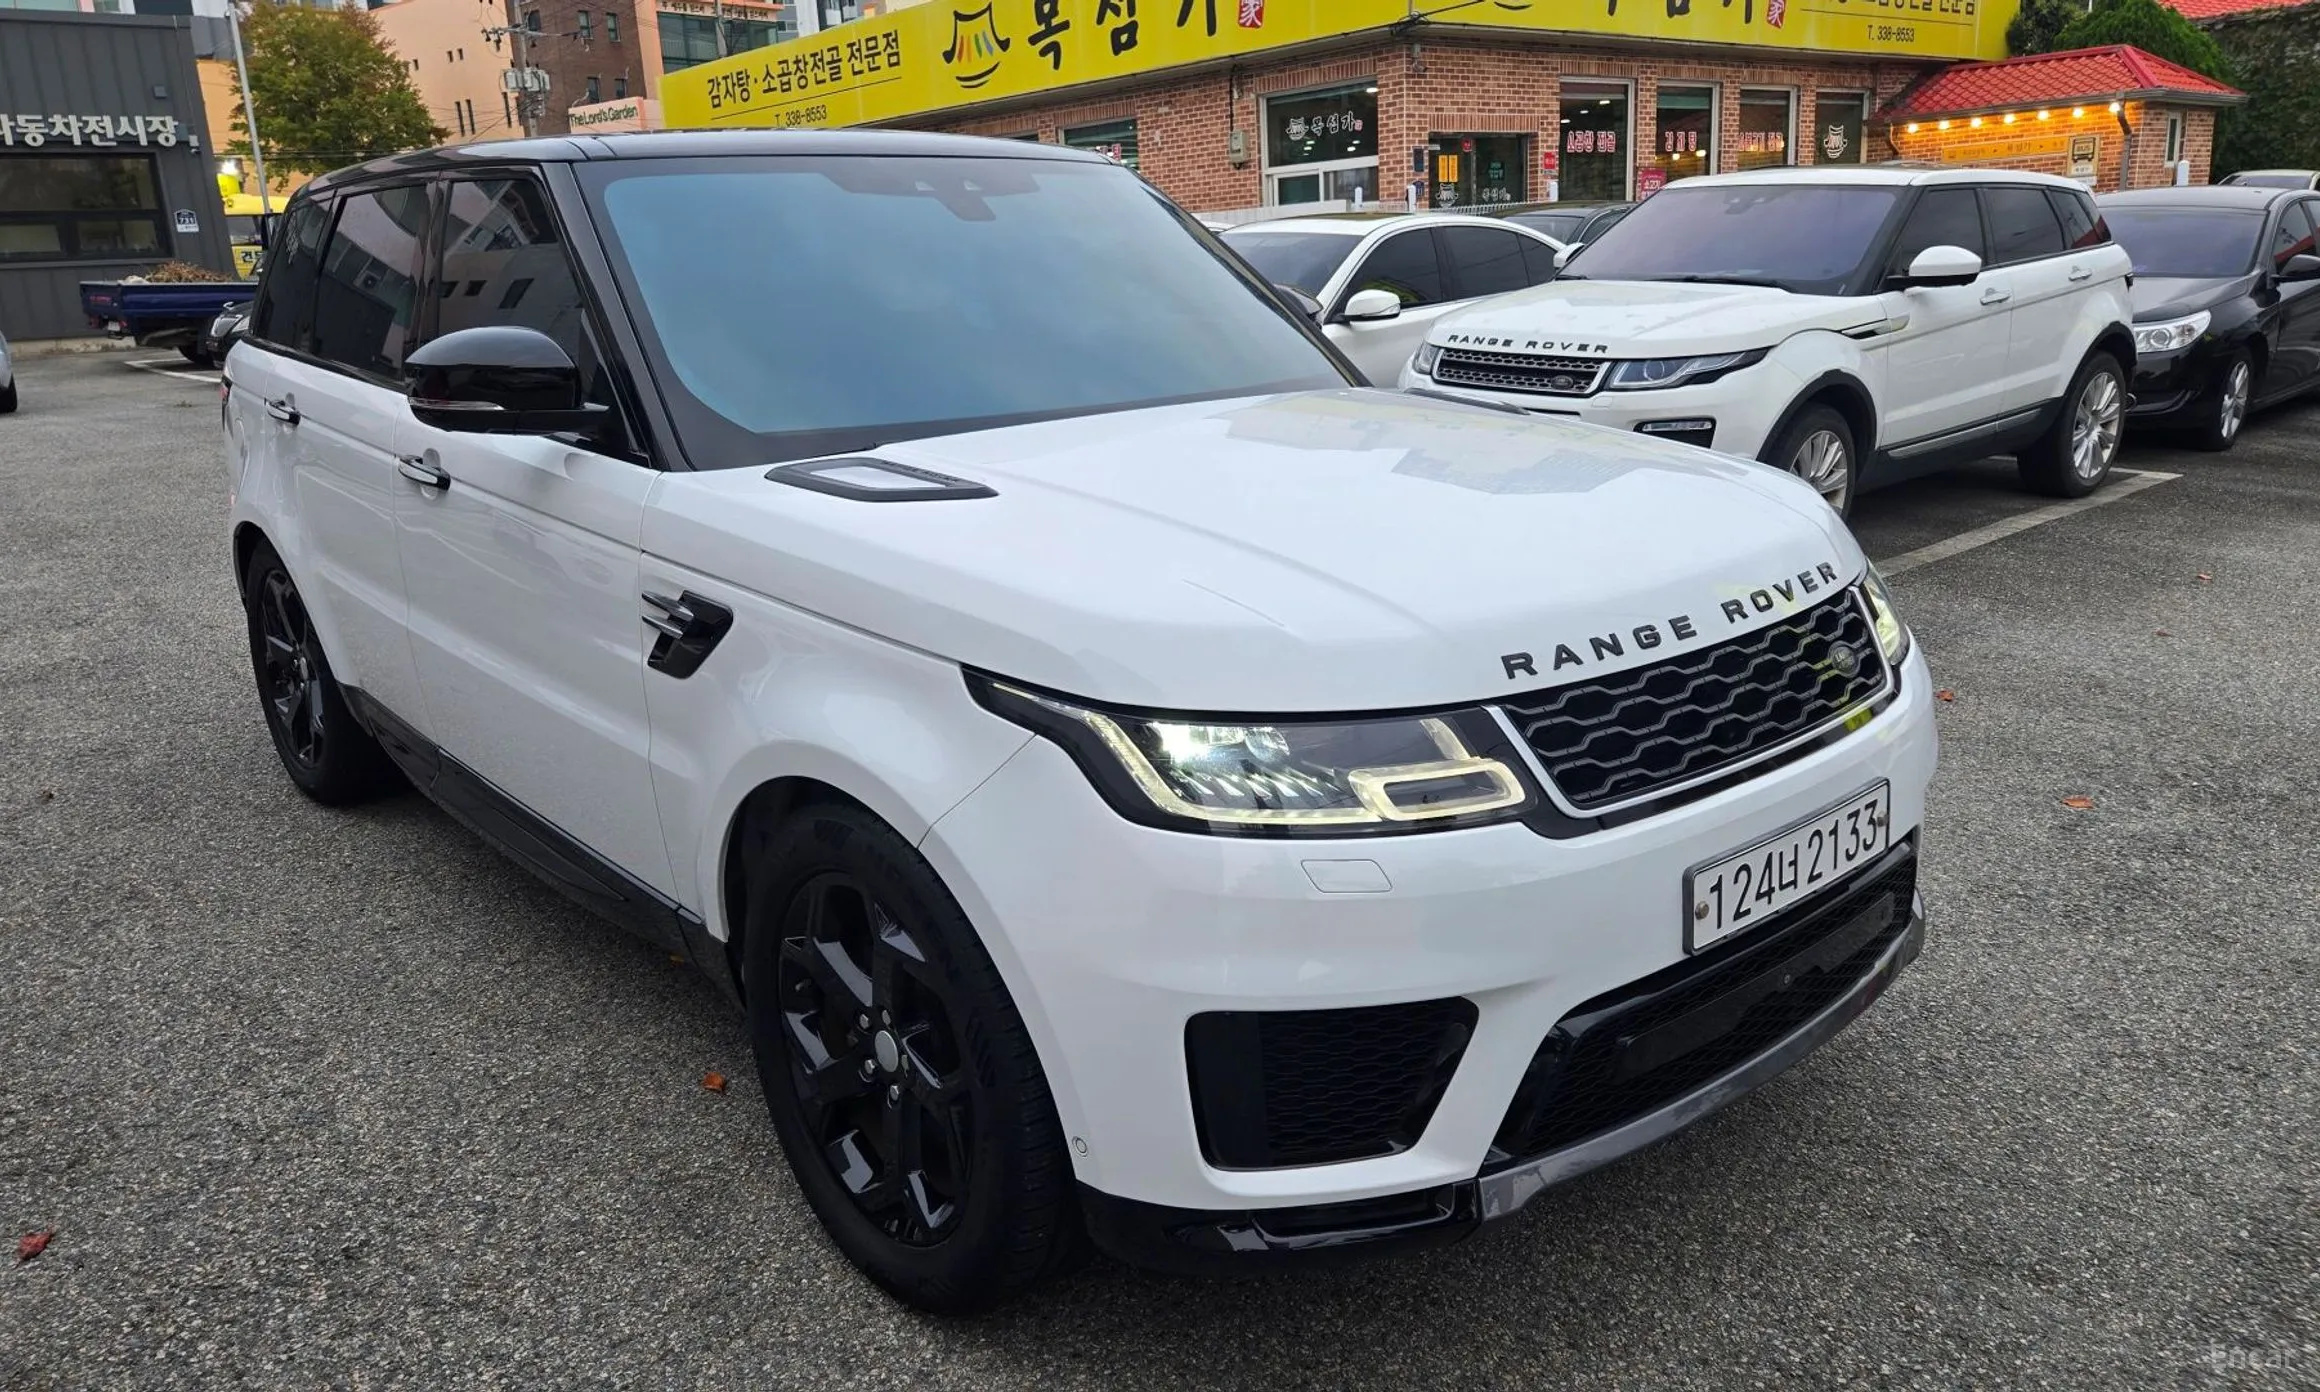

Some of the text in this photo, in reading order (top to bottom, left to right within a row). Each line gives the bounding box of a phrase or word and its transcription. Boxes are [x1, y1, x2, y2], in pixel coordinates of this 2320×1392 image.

[847, 30, 901, 76] 전문점
[608, 104, 638, 121] Garden
[1447, 334, 1608, 354] RANGE ROVER
[1500, 561, 1838, 680] RANGE ROVER
[1807, 798, 1878, 885] 2133
